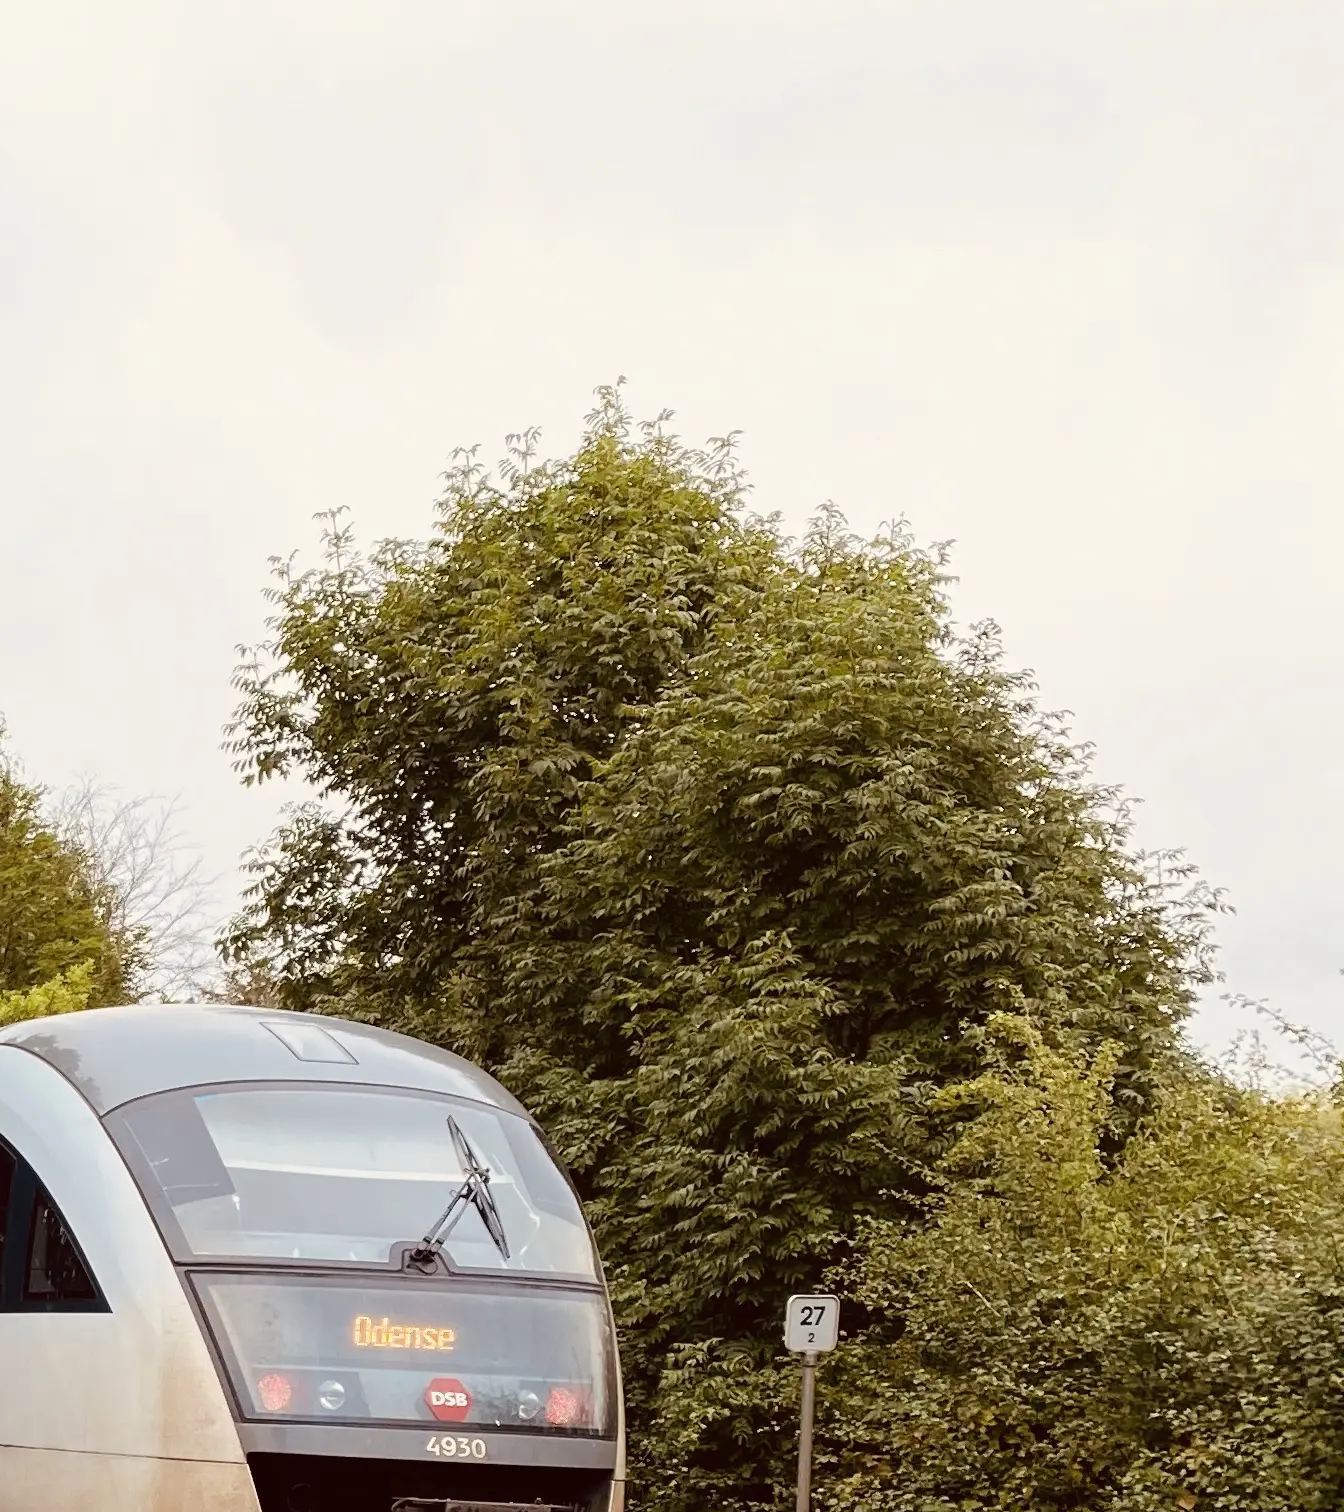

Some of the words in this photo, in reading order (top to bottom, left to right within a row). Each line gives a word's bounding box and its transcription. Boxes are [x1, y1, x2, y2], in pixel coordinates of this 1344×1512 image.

[800, 1306, 826, 1326] 27
[354, 1316, 455, 1350] Odense
[807, 1332, 815, 1343] 2
[431, 1391, 468, 1407] DSB
[426, 1436, 487, 1459] 4930
